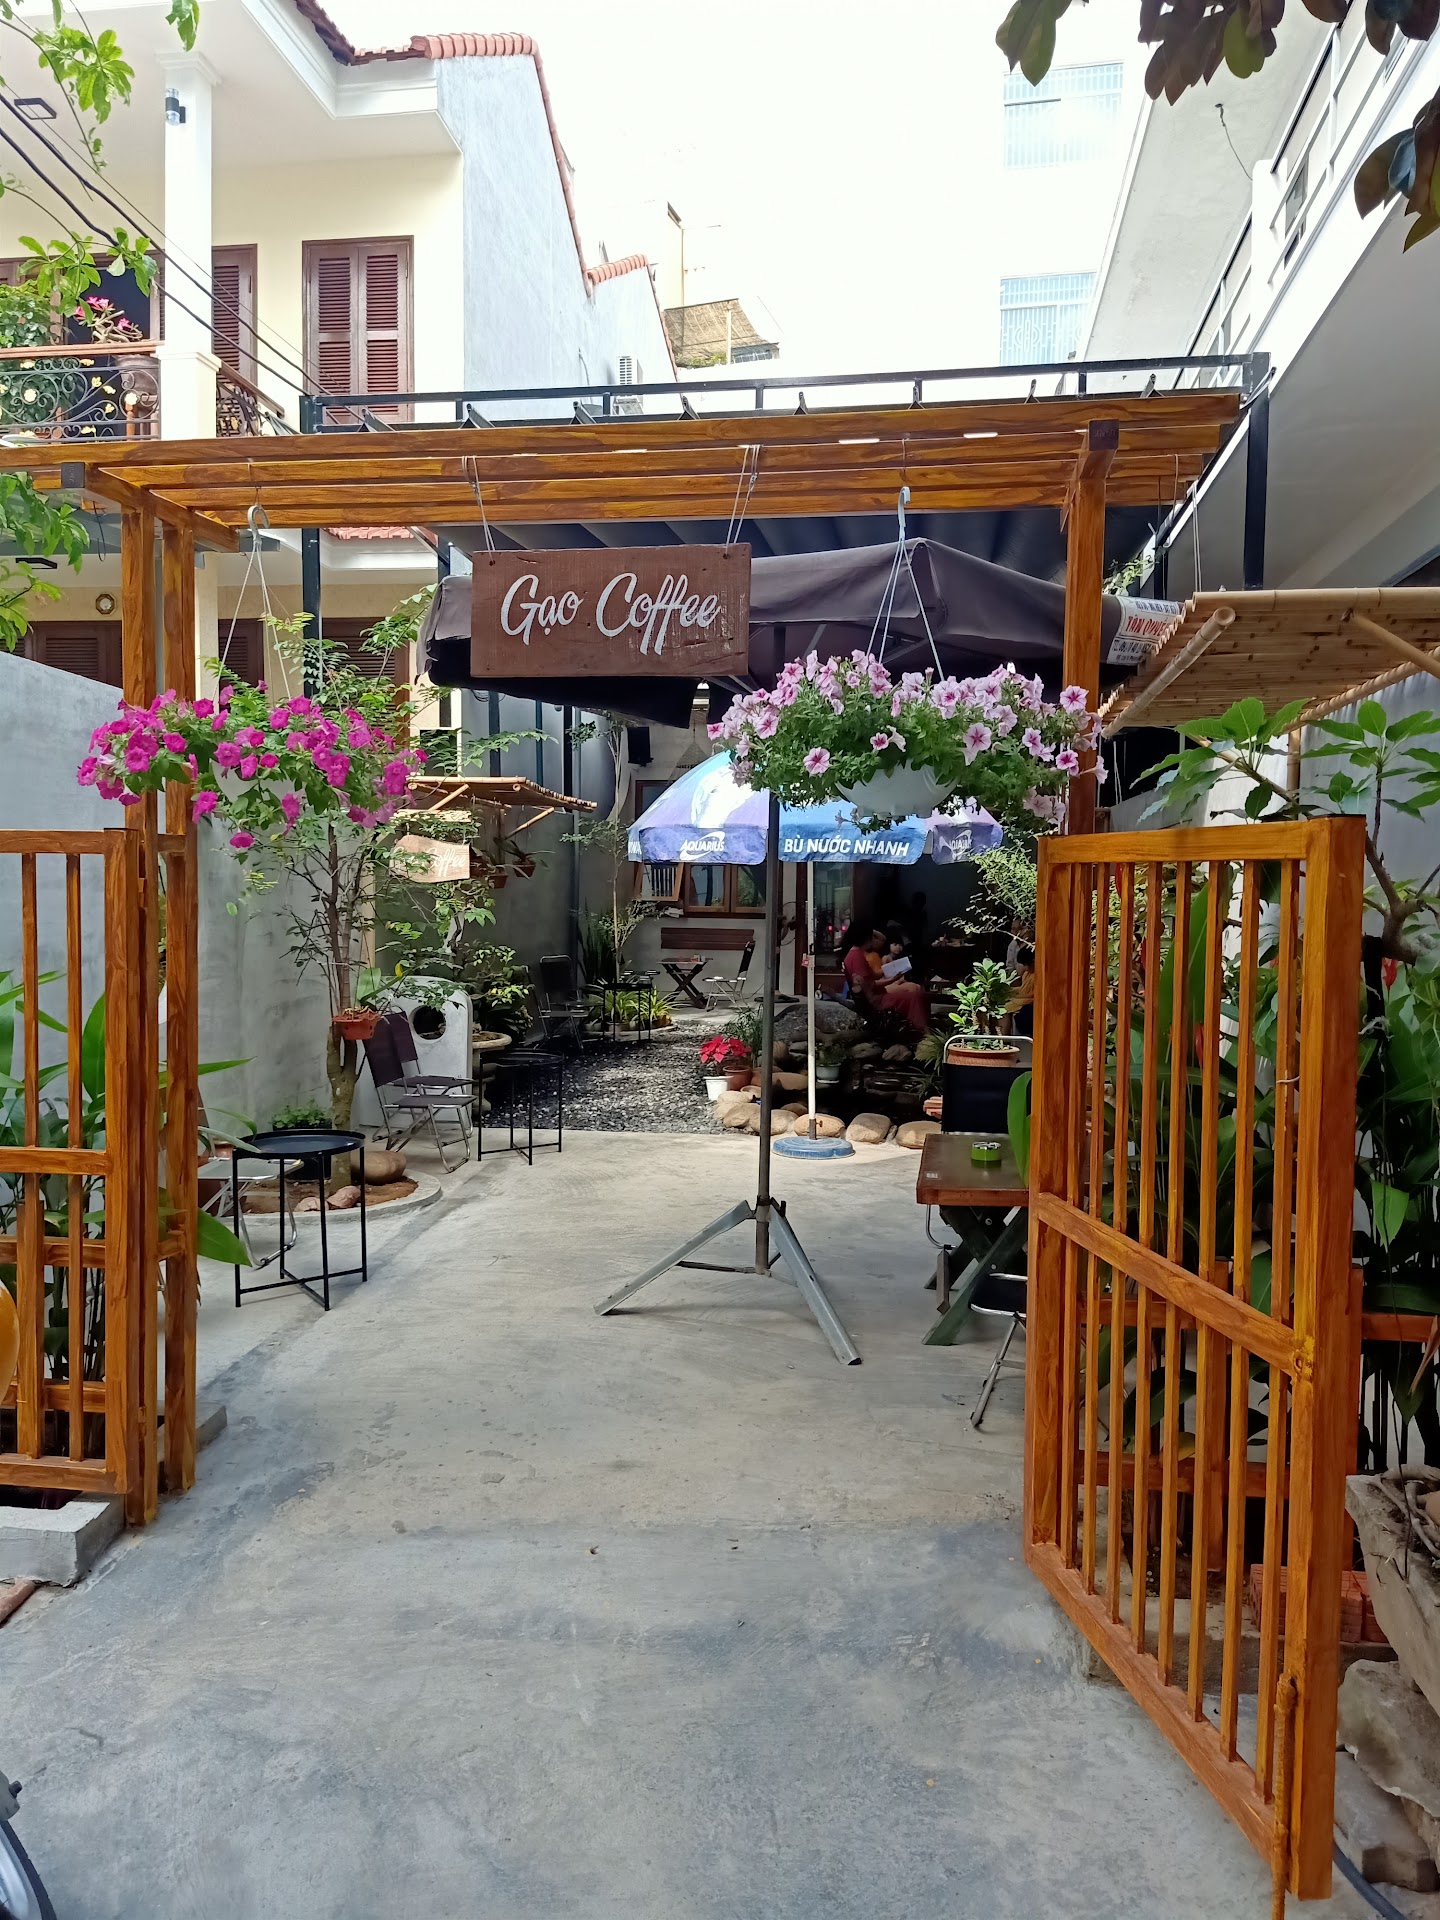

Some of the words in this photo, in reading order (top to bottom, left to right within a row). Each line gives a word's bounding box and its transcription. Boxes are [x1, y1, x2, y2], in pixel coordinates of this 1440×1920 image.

[500, 574, 584, 645] Gạo
[596, 572, 722, 656] Coffee
[1126, 614, 1146, 633] TÂN
[1142, 617, 1169, 637] QUYẾ
[680, 838, 726, 852] AQUARIUS
[783, 834, 804, 853] BÙ
[806, 834, 852, 854] NƯỚC
[853, 839, 910, 857] NHANH
